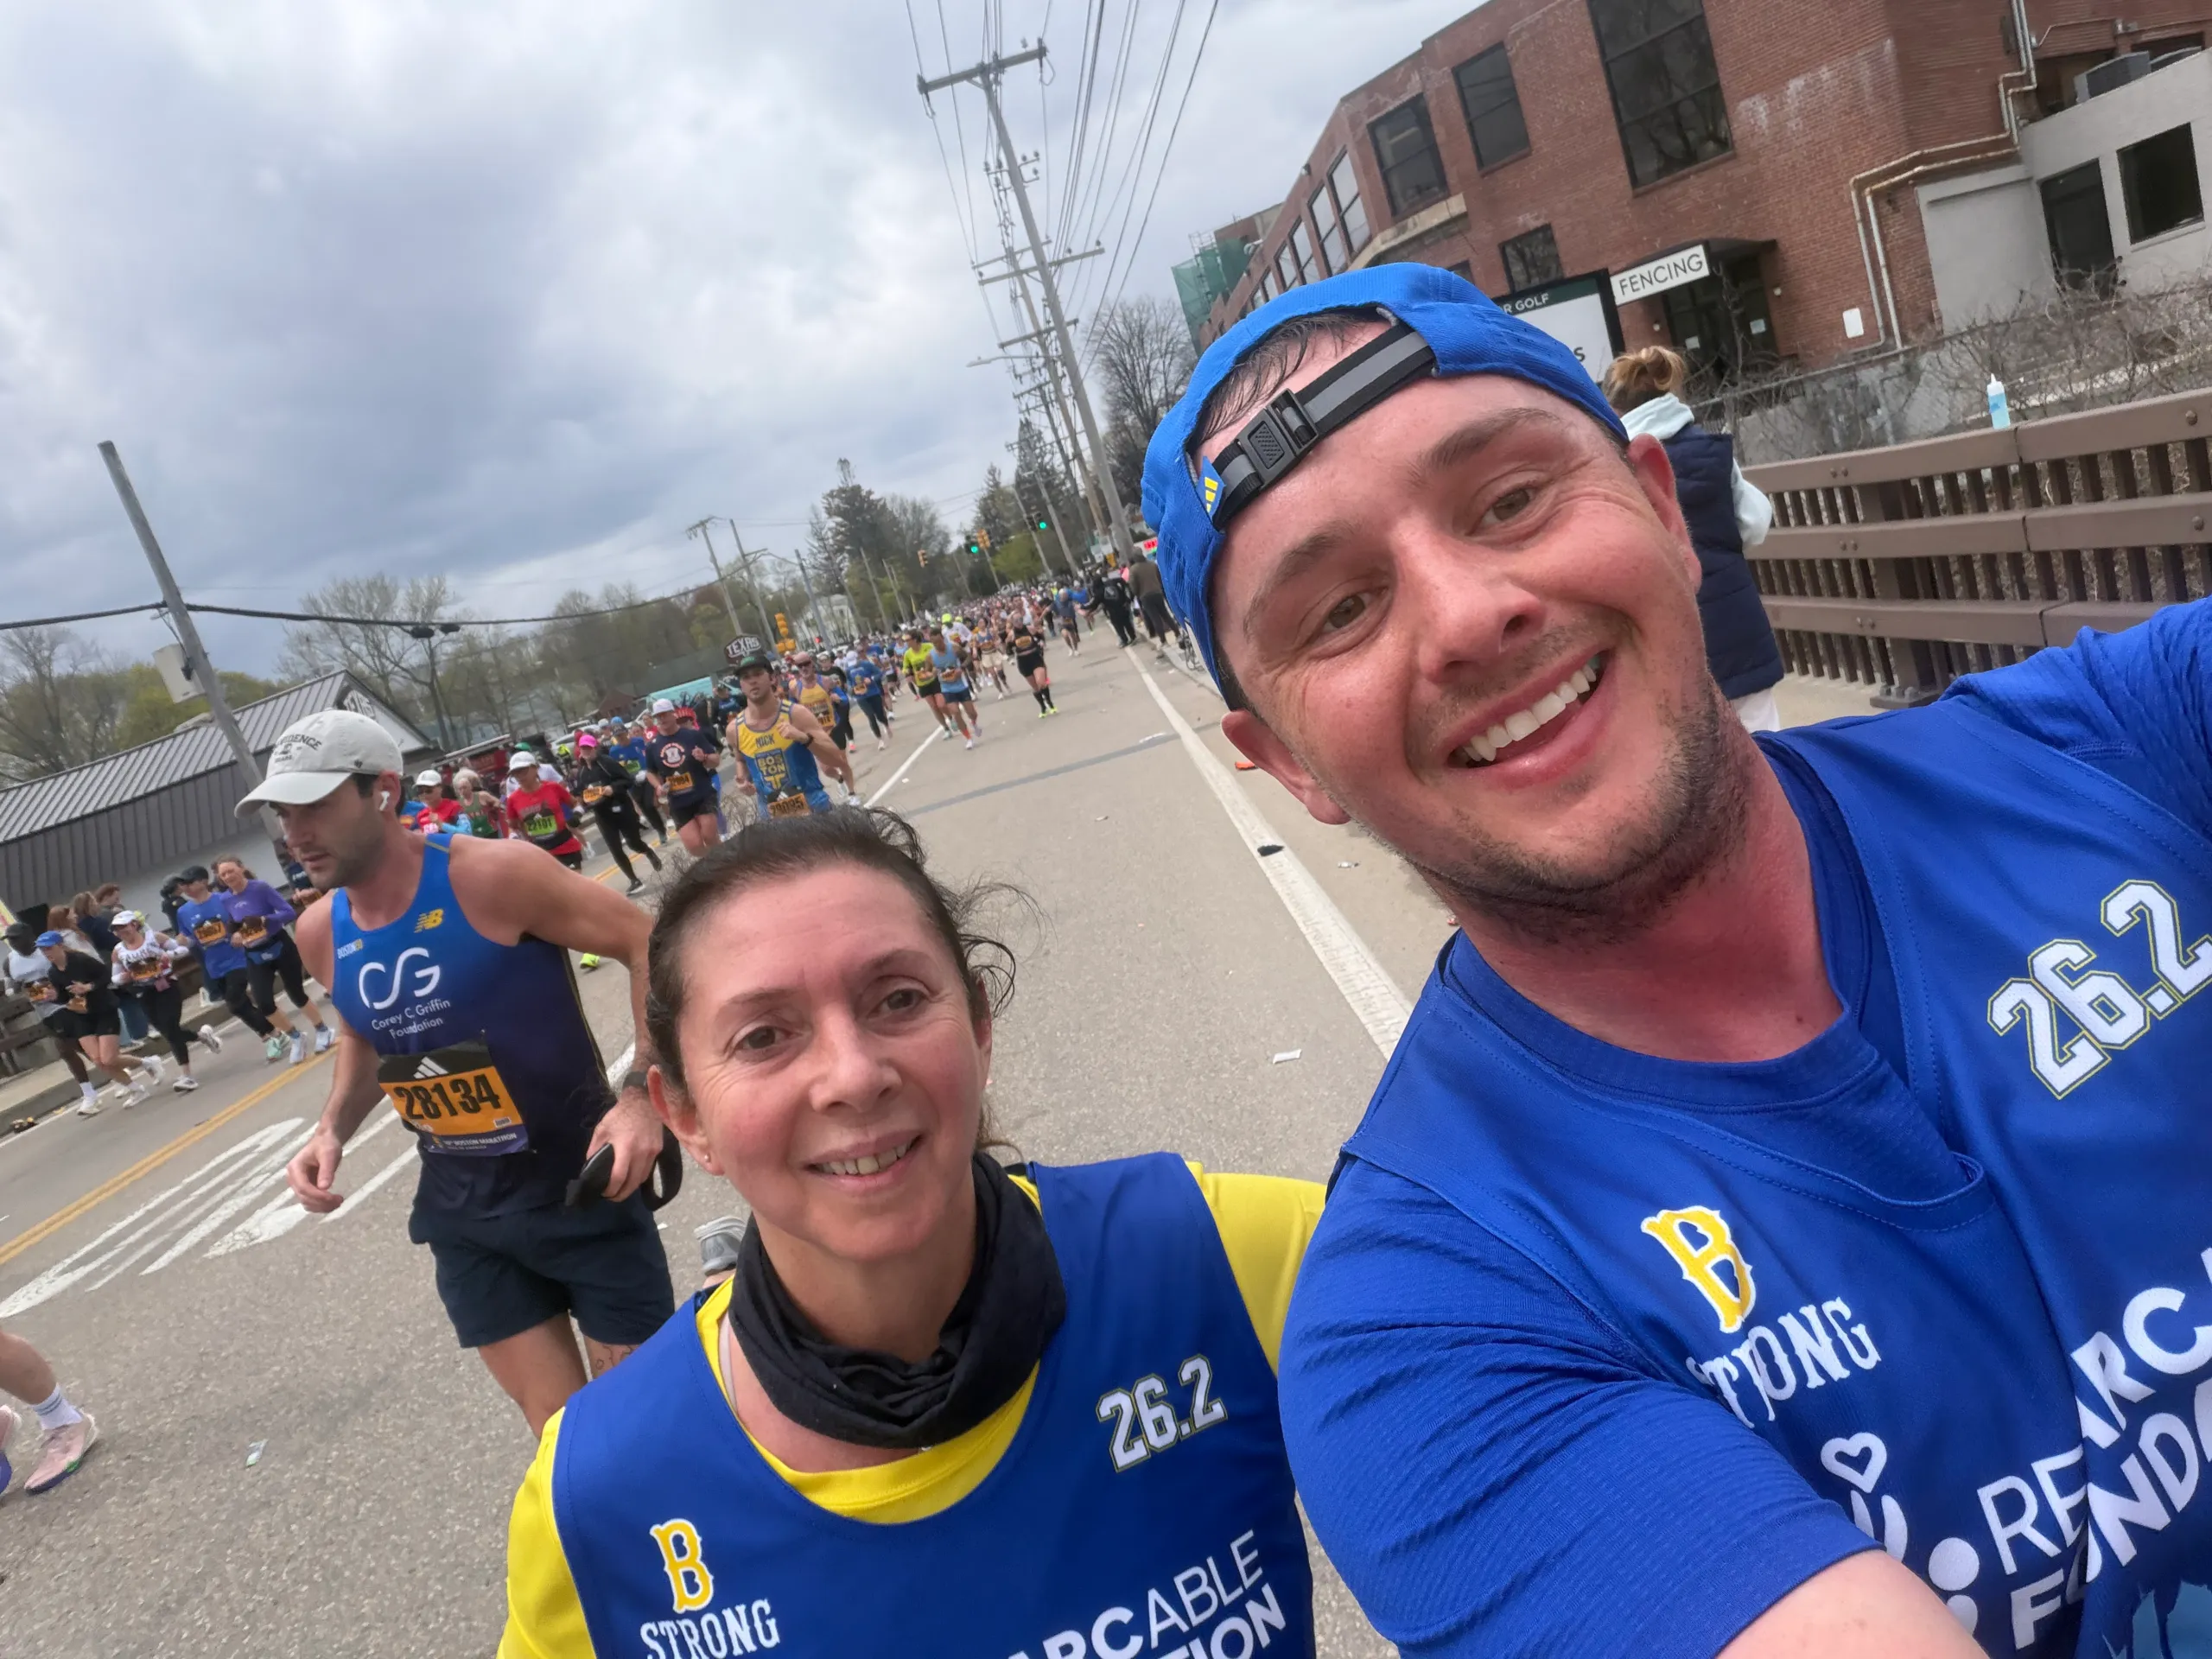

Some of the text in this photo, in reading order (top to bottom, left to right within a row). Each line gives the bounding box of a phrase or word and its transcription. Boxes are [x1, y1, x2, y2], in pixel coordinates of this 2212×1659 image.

[1618, 253, 1704, 296] FENCING
[1515, 292, 1549, 311] GOLF
[726, 636, 760, 656] TEXAS
[755, 734, 776, 748] NICK
[1986, 879, 2212, 1101] 26.2
[372, 1014, 403, 1031] Corey
[416, 998, 451, 1016] Griffin
[389, 1017, 444, 1039] Foundation
[393, 1073, 500, 1120] 28134
[1640, 1205, 1757, 1334] B
[1096, 1352, 1229, 1474] 26.2
[649, 1518, 715, 1615] B
[639, 1597, 781, 1659] STRONG
